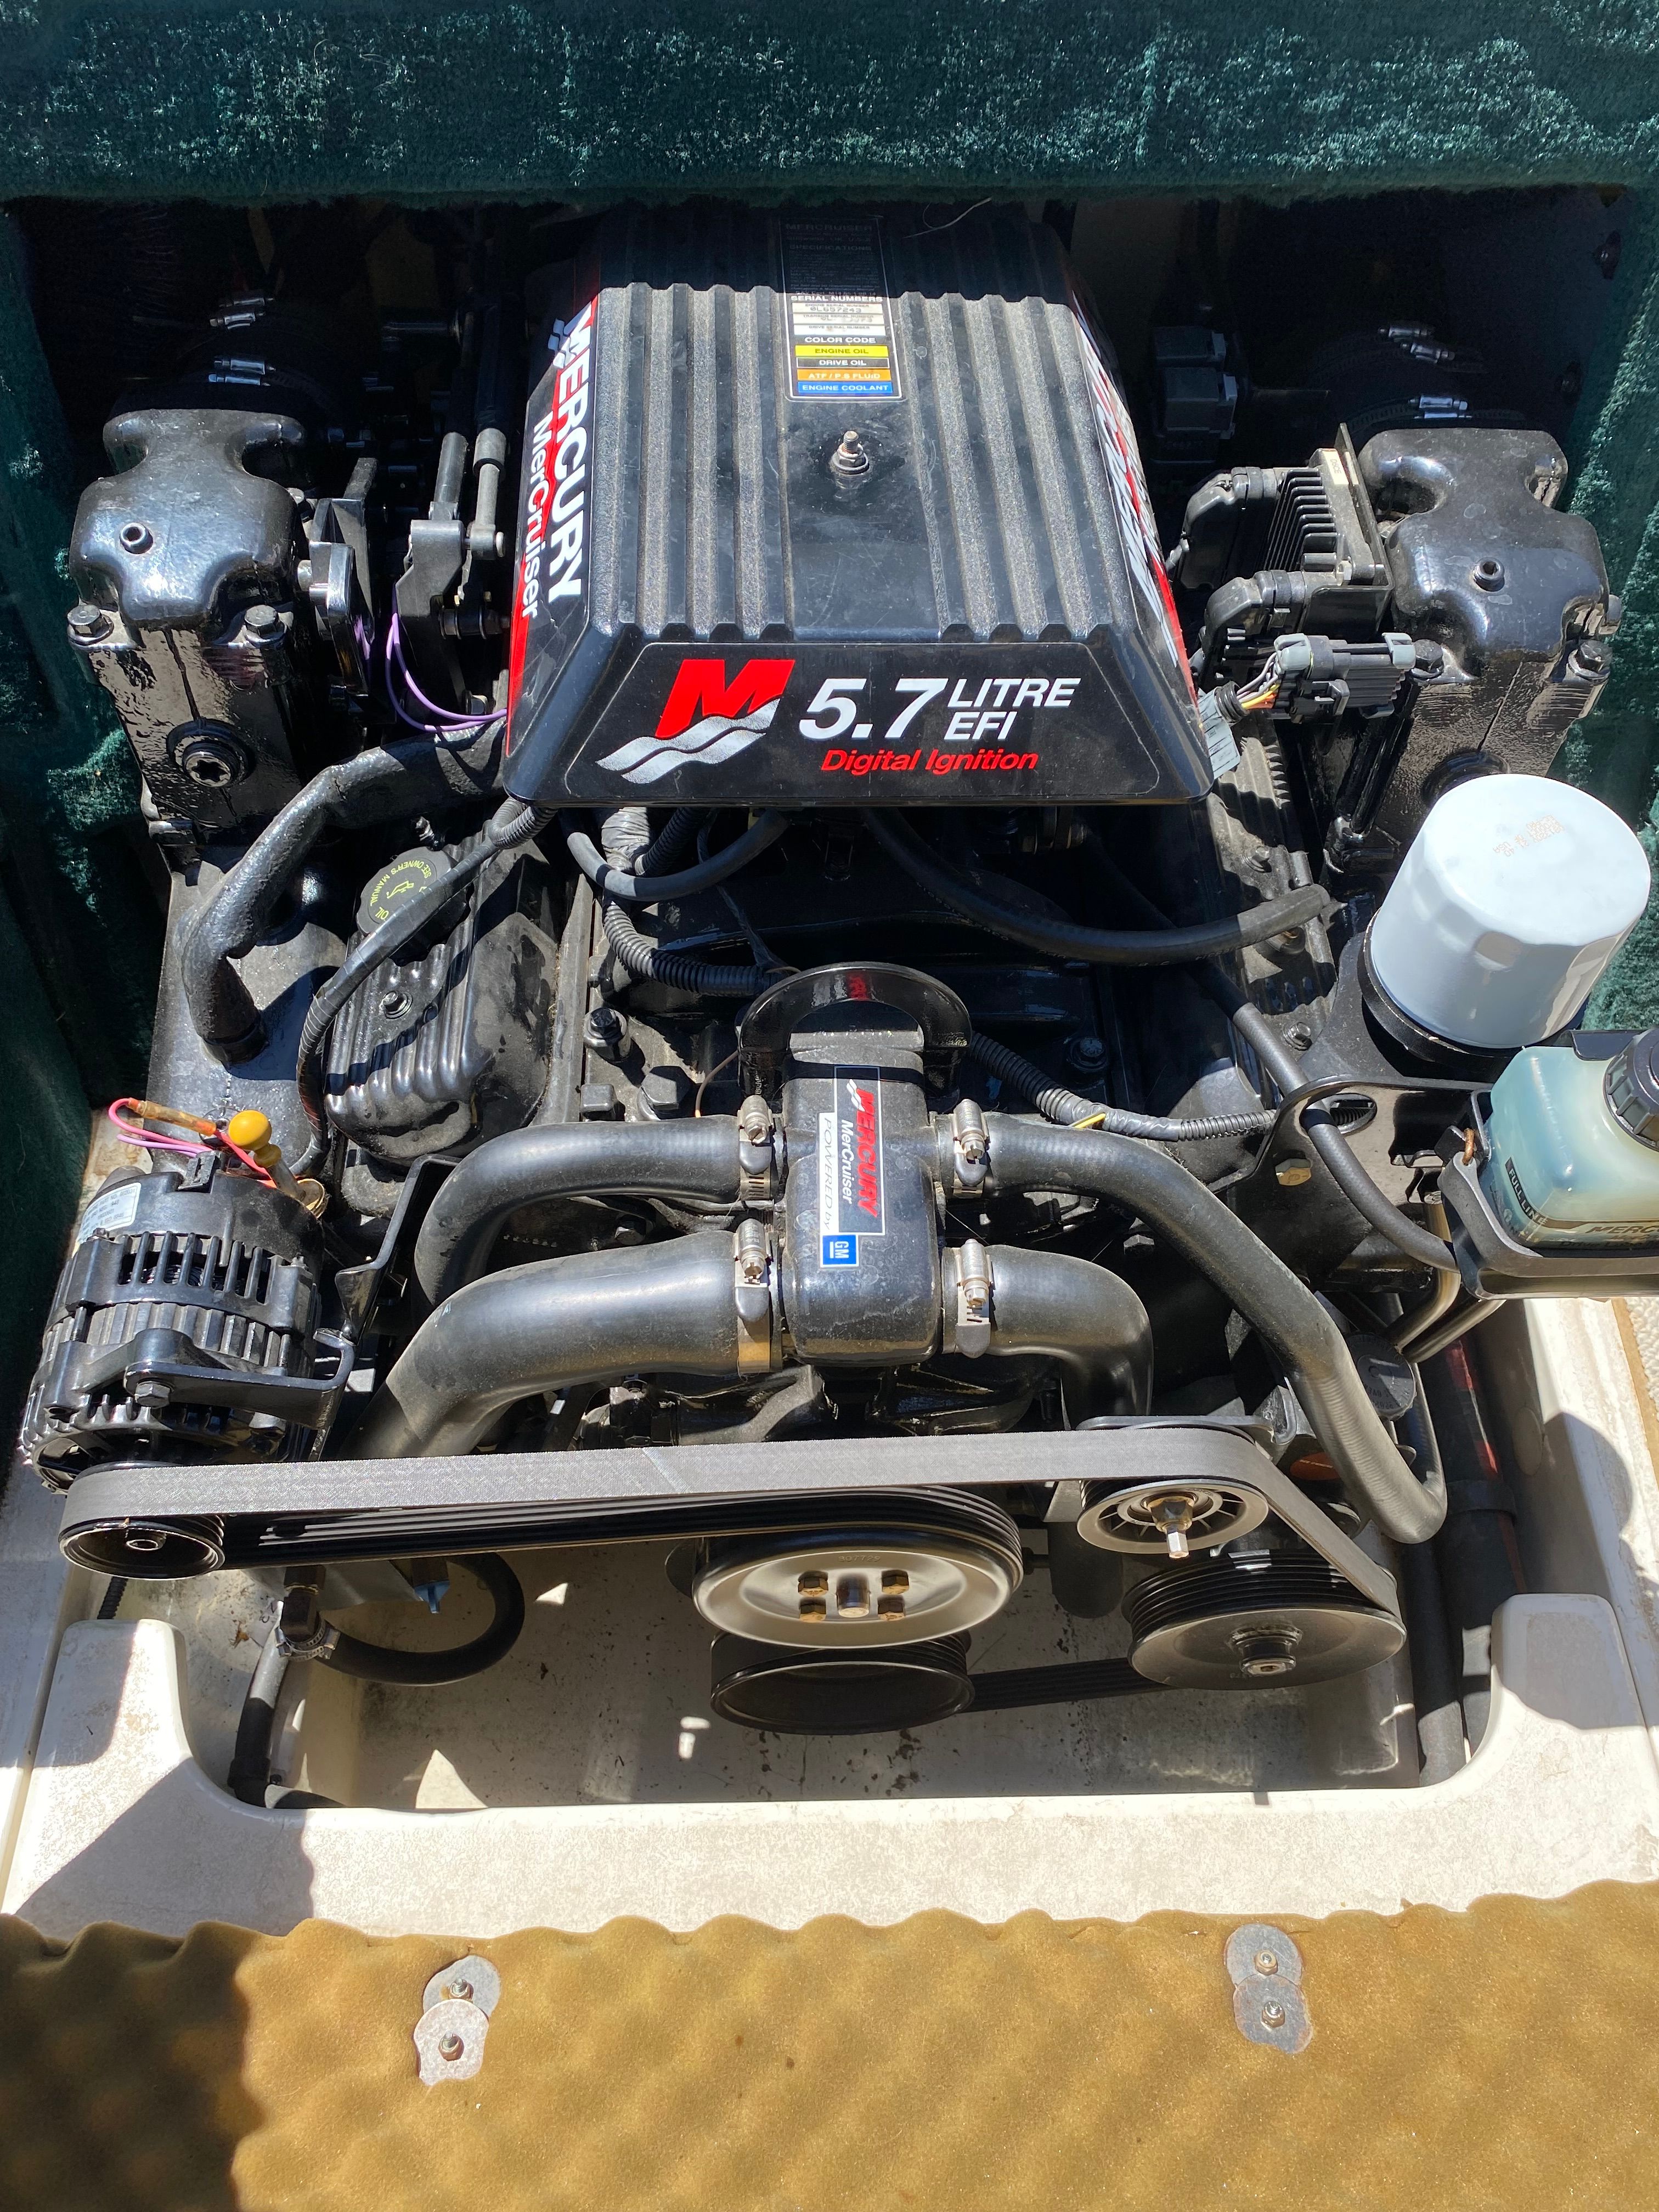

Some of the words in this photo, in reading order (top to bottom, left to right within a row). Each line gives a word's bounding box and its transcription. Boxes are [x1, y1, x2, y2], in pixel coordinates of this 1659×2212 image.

[549, 301, 592, 603] MERCURY
[522, 410, 555, 619] MerCruiser
[799, 678, 949, 740] 5.7
[947, 678, 1081, 707] LITRE
[944, 712, 1017, 740] EFI
[821, 748, 921, 776] Digital
[925, 748, 1039, 776] Ignition
[391, 860, 425, 875] OWNER'S
[421, 865, 432, 878] SEE
[370, 874, 391, 906] MANUAL
[375, 907, 390, 920] OIL
[824, 1118, 833, 1209] POWERED
[841, 1119, 855, 1204] MerCruiser
[856, 1088, 878, 1217] MERCURY
[1509, 1168, 1522, 1200] FULL
[1521, 1200, 1548, 1225] LINE
[824, 1212, 832, 1230] by
[1585, 1225, 1659, 1234] MERC
[834, 1240, 849, 1259] GM
